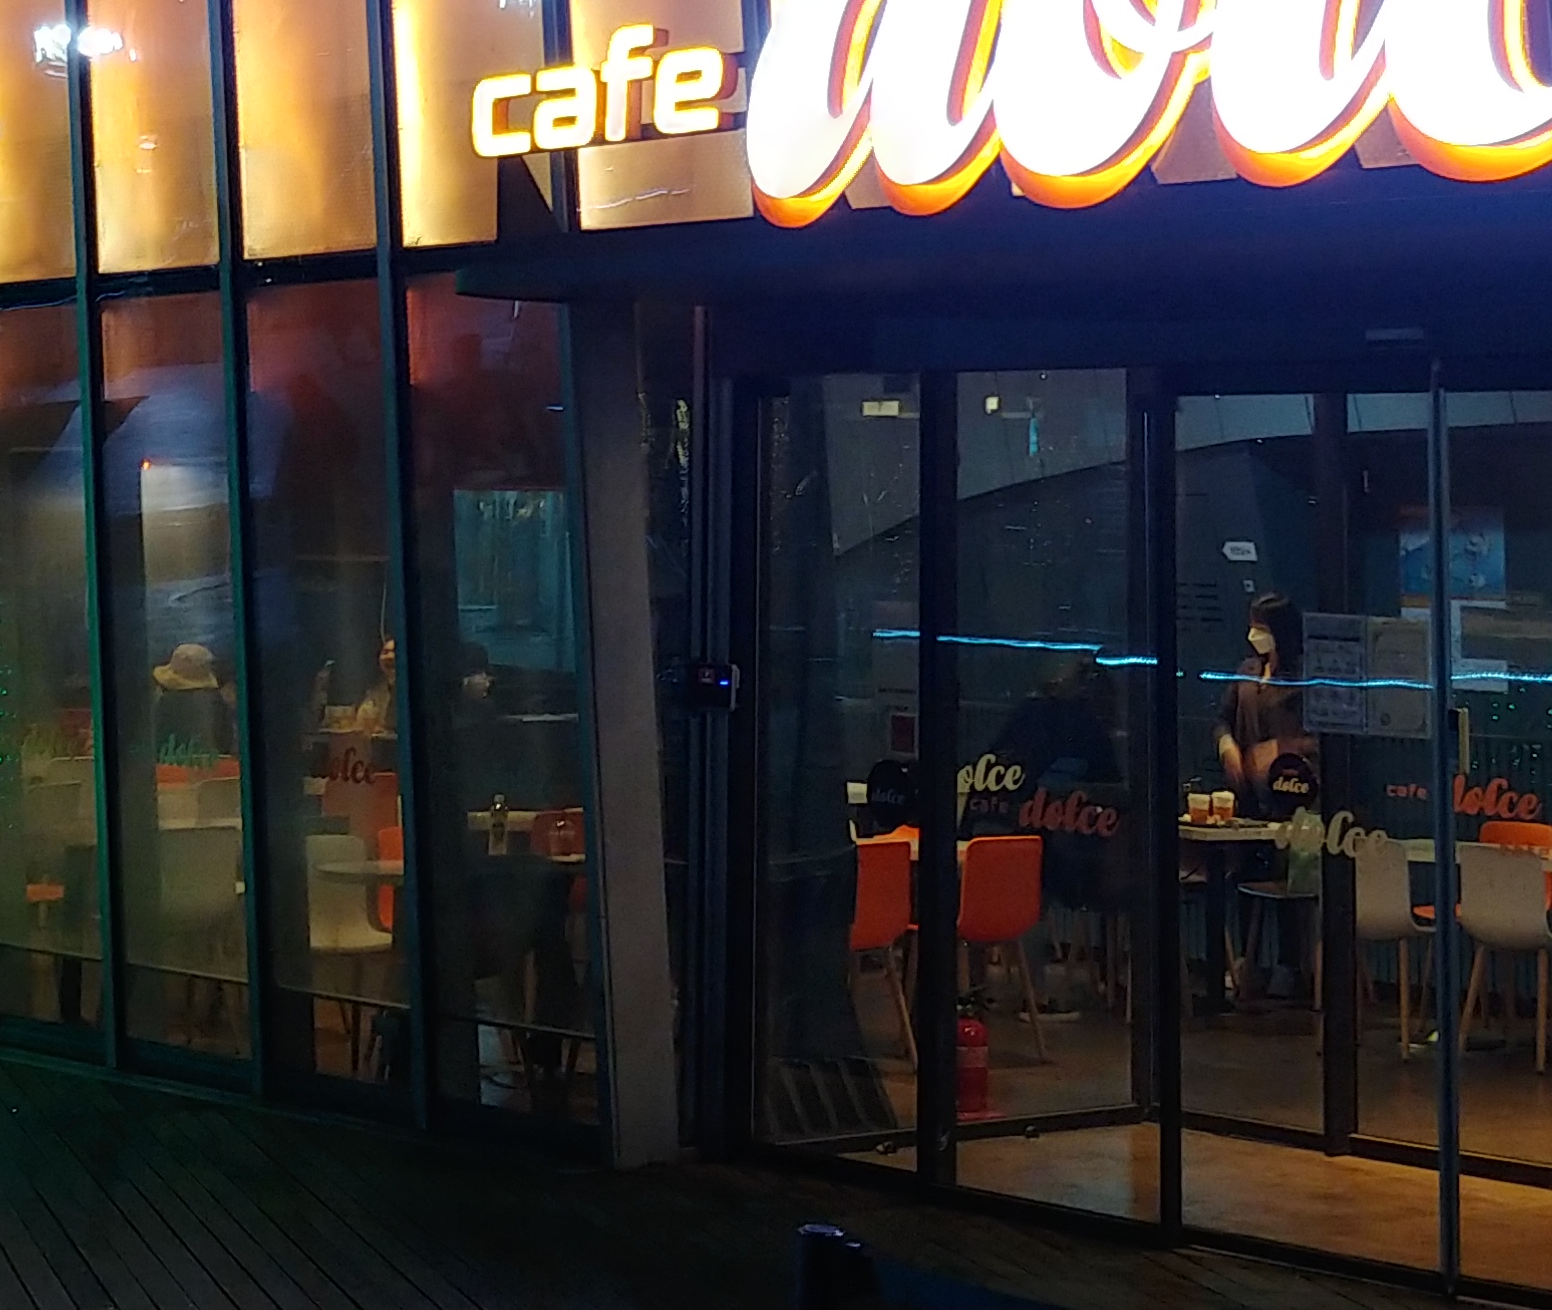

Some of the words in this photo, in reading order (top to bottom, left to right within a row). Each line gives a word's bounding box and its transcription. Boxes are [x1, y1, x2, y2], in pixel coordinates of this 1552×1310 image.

[471, 23, 729, 158] cafe
[956, 753, 1026, 792] olce
[1272, 775, 1310, 793] dolce
[1386, 784, 1428, 800] cafe
[1019, 786, 1119, 837] dolce
